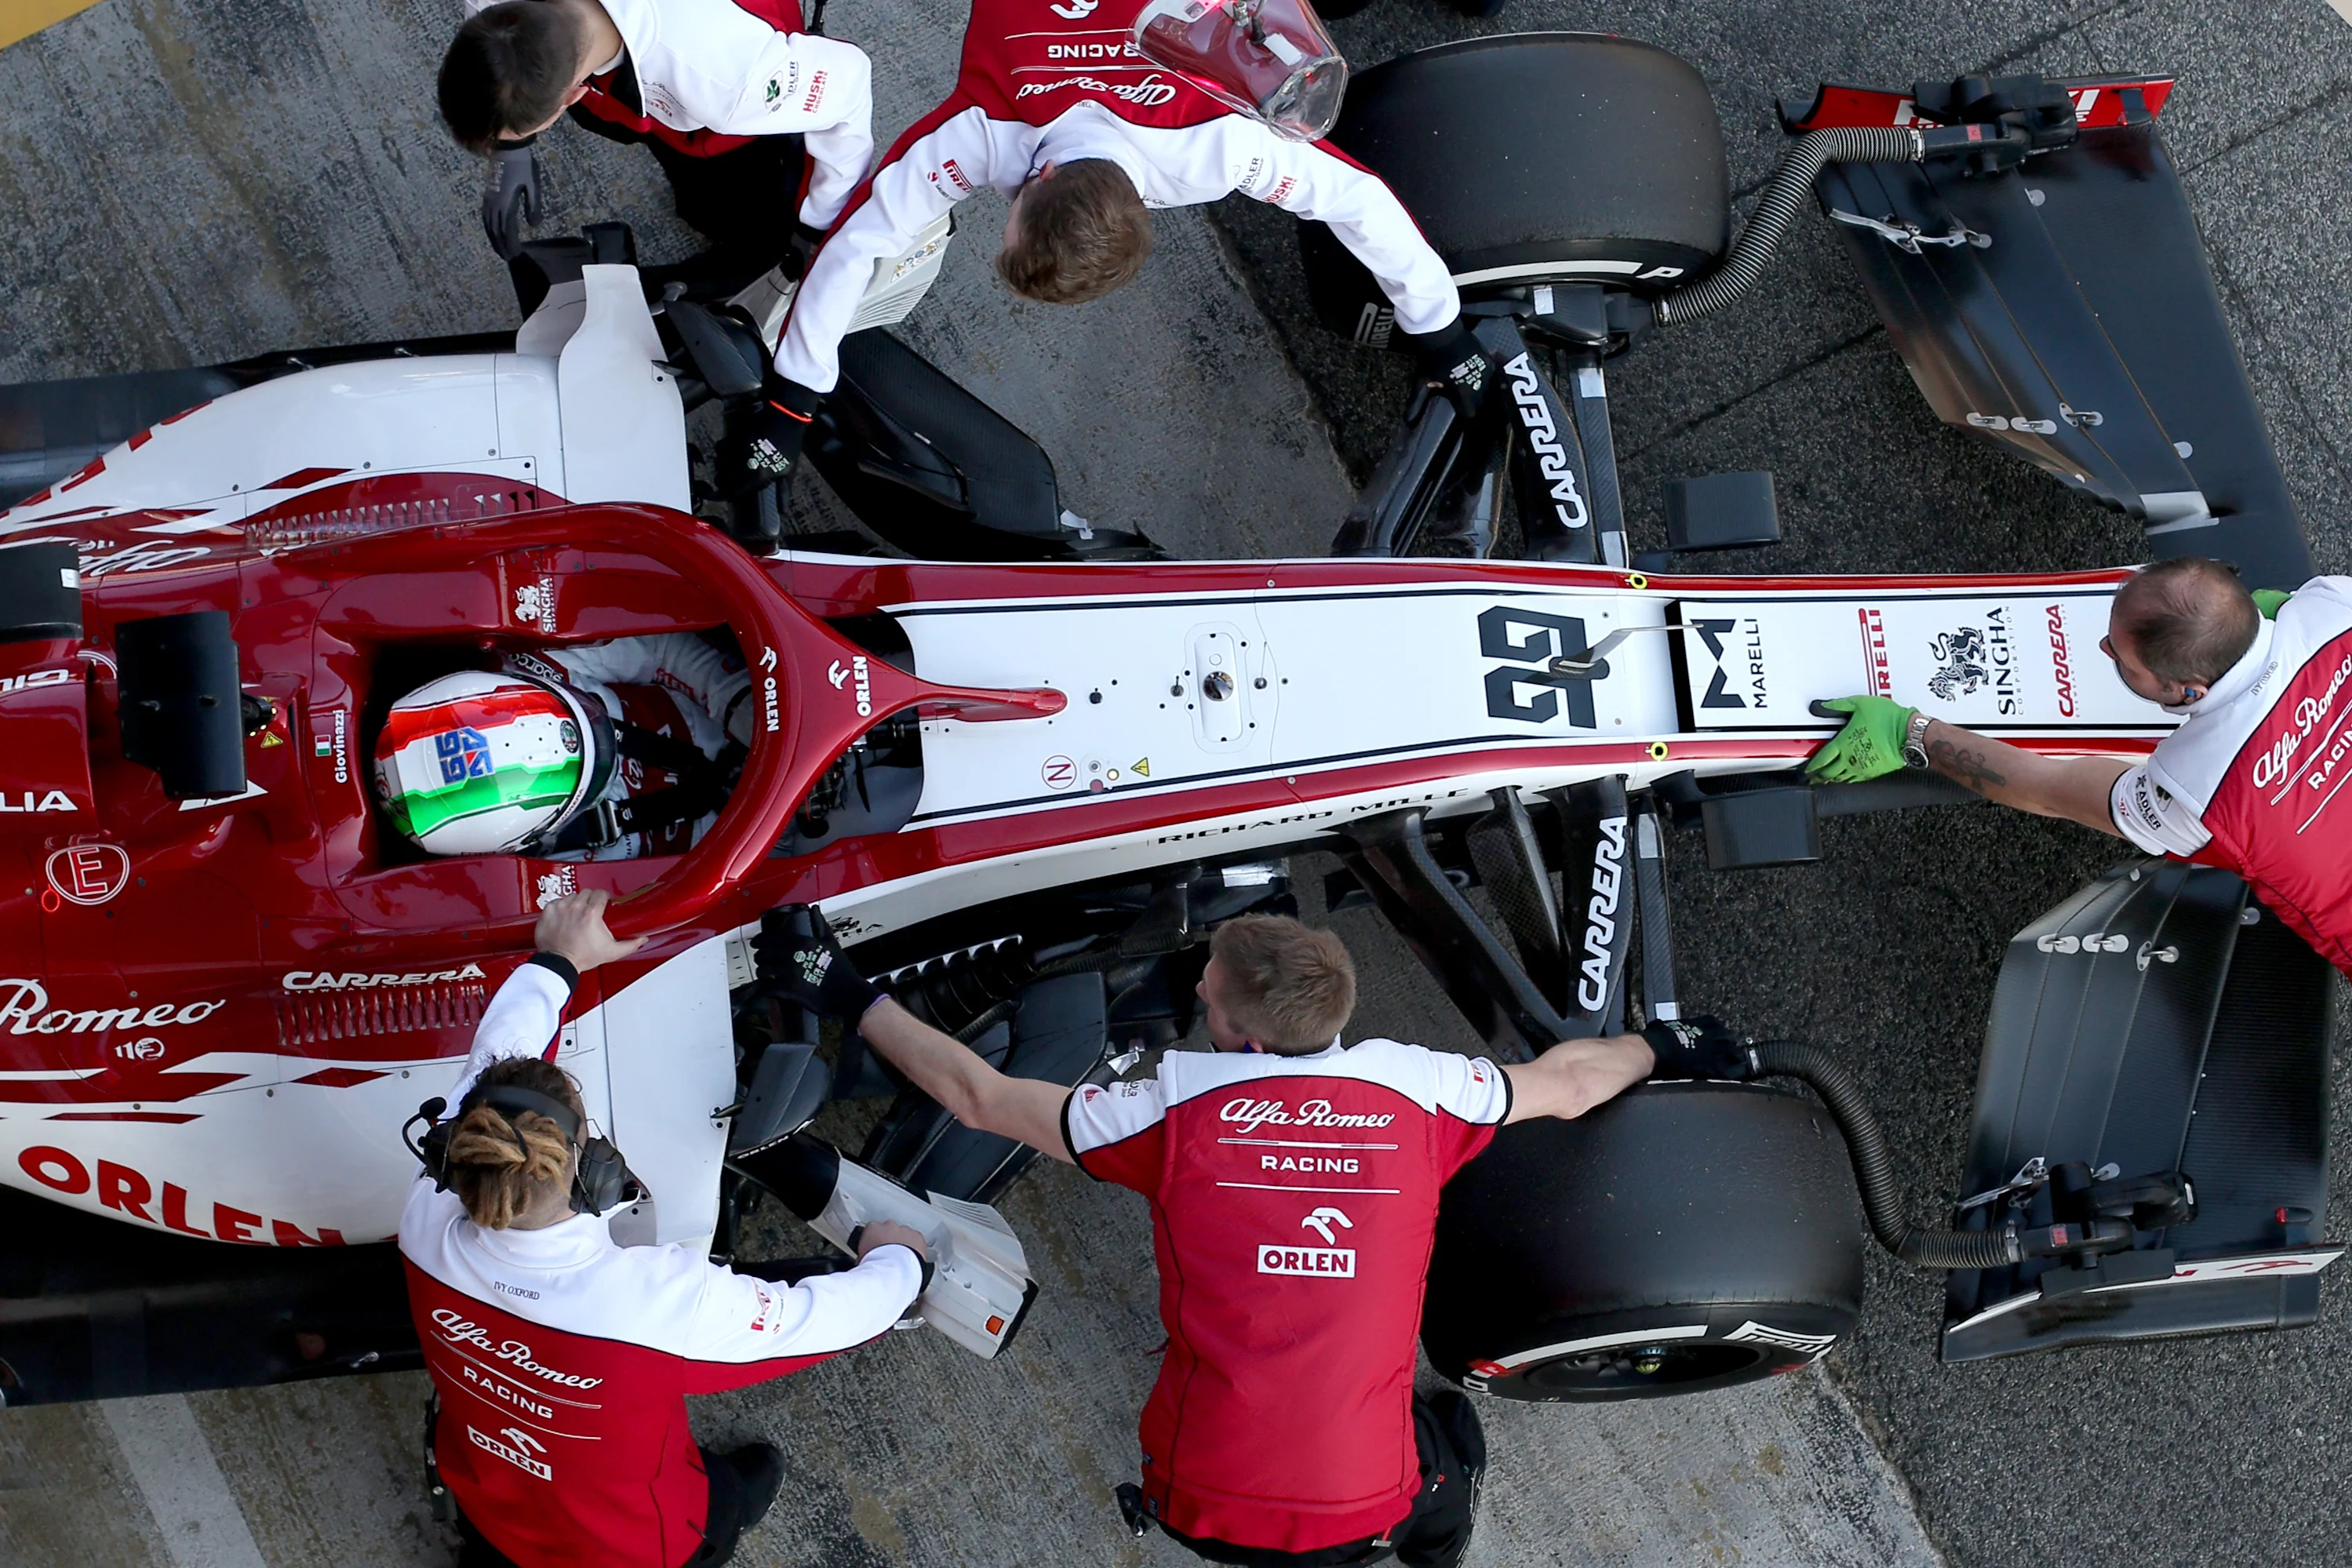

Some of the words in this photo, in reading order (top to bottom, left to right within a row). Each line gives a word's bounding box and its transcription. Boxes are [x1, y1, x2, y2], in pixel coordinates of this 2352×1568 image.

[788, 60, 796, 93] DLER
[803, 70, 827, 113] HUSKI
[1015, 76, 1109, 100] Romeo
[1109, 73, 1177, 107] Alfa
[1238, 157, 1260, 190] ADLER
[1503, 351, 1589, 529] CARRERA
[540, 577, 553, 633] SINGHA
[852, 655, 872, 717] ORLEN
[1744, 617, 1768, 708] MARELLI
[1986, 606, 2016, 715] SINGHA
[2004, 606, 2024, 715] CORPORATION
[2045, 604, 2073, 718] CARRERA
[763, 676, 780, 733] ORLEN
[2249, 682, 2263, 697] IVY
[333, 709, 348, 784] Giovinazzi
[2252, 730, 2303, 788] Alfa
[2292, 653, 2352, 739] Romeo
[1158, 811, 1333, 845] RICHARD
[1350, 787, 1469, 813] MILLE
[2139, 791, 2162, 829] ADLER
[1578, 816, 1627, 1012] CARRERA
[282, 960, 487, 990] CARRERA
[0, 978, 226, 1035] Romeo
[1220, 1097, 1293, 1134] Alfa
[1293, 1099, 1396, 1128] Romeo
[1261, 1155, 1360, 1174] RACING
[17, 1145, 348, 1247] ORLEN
[1263, 1250, 1349, 1273] ORLEN
[493, 1281, 507, 1292] IVY
[508, 1286, 541, 1301] OXFORD
[431, 1308, 497, 1342] Alfa
[494, 1340, 603, 1390] Romeo
[464, 1366, 553, 1419] RACING
[471, 1432, 547, 1478] ORLEN
